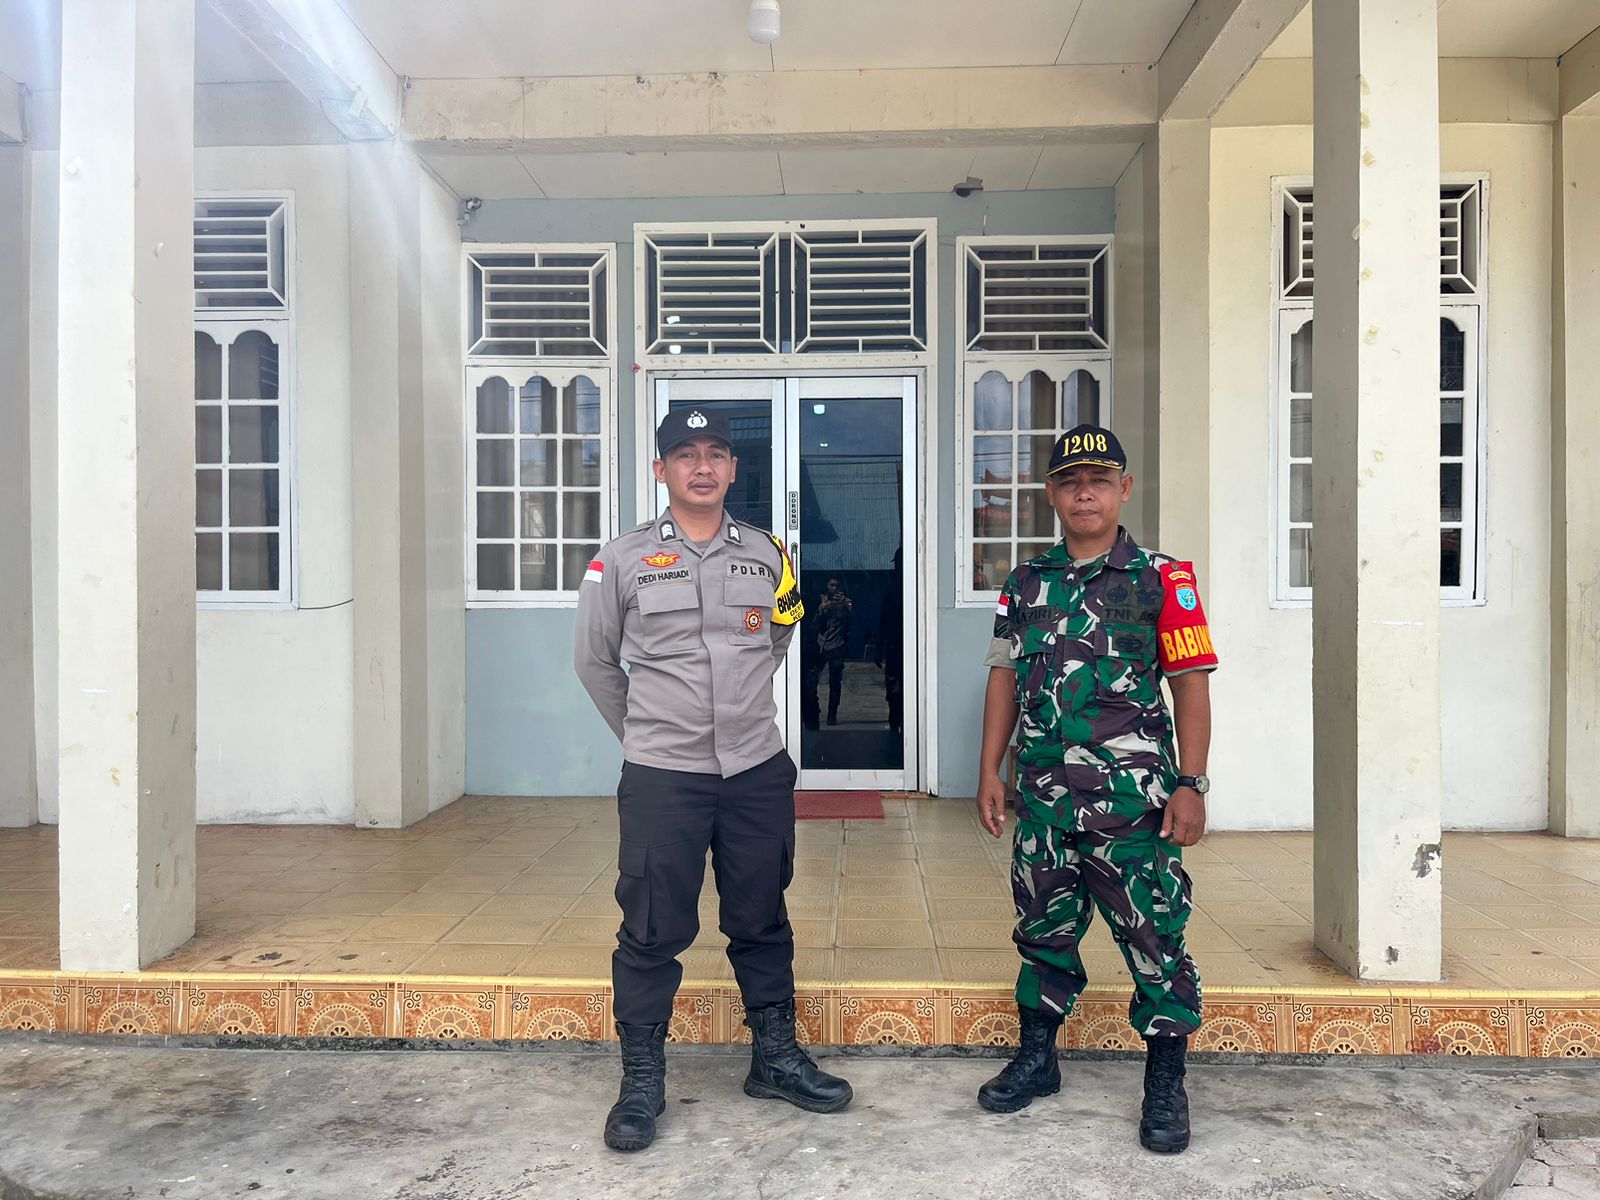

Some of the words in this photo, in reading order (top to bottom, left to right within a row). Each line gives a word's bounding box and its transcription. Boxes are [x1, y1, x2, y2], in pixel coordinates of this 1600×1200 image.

[1062, 433, 1108, 457] 1208
[637, 573, 657, 586] DEDI
[658, 570, 690, 581] HARIADI
[730, 564, 771, 578] POLRI
[1105, 607, 1130, 620] TNI
